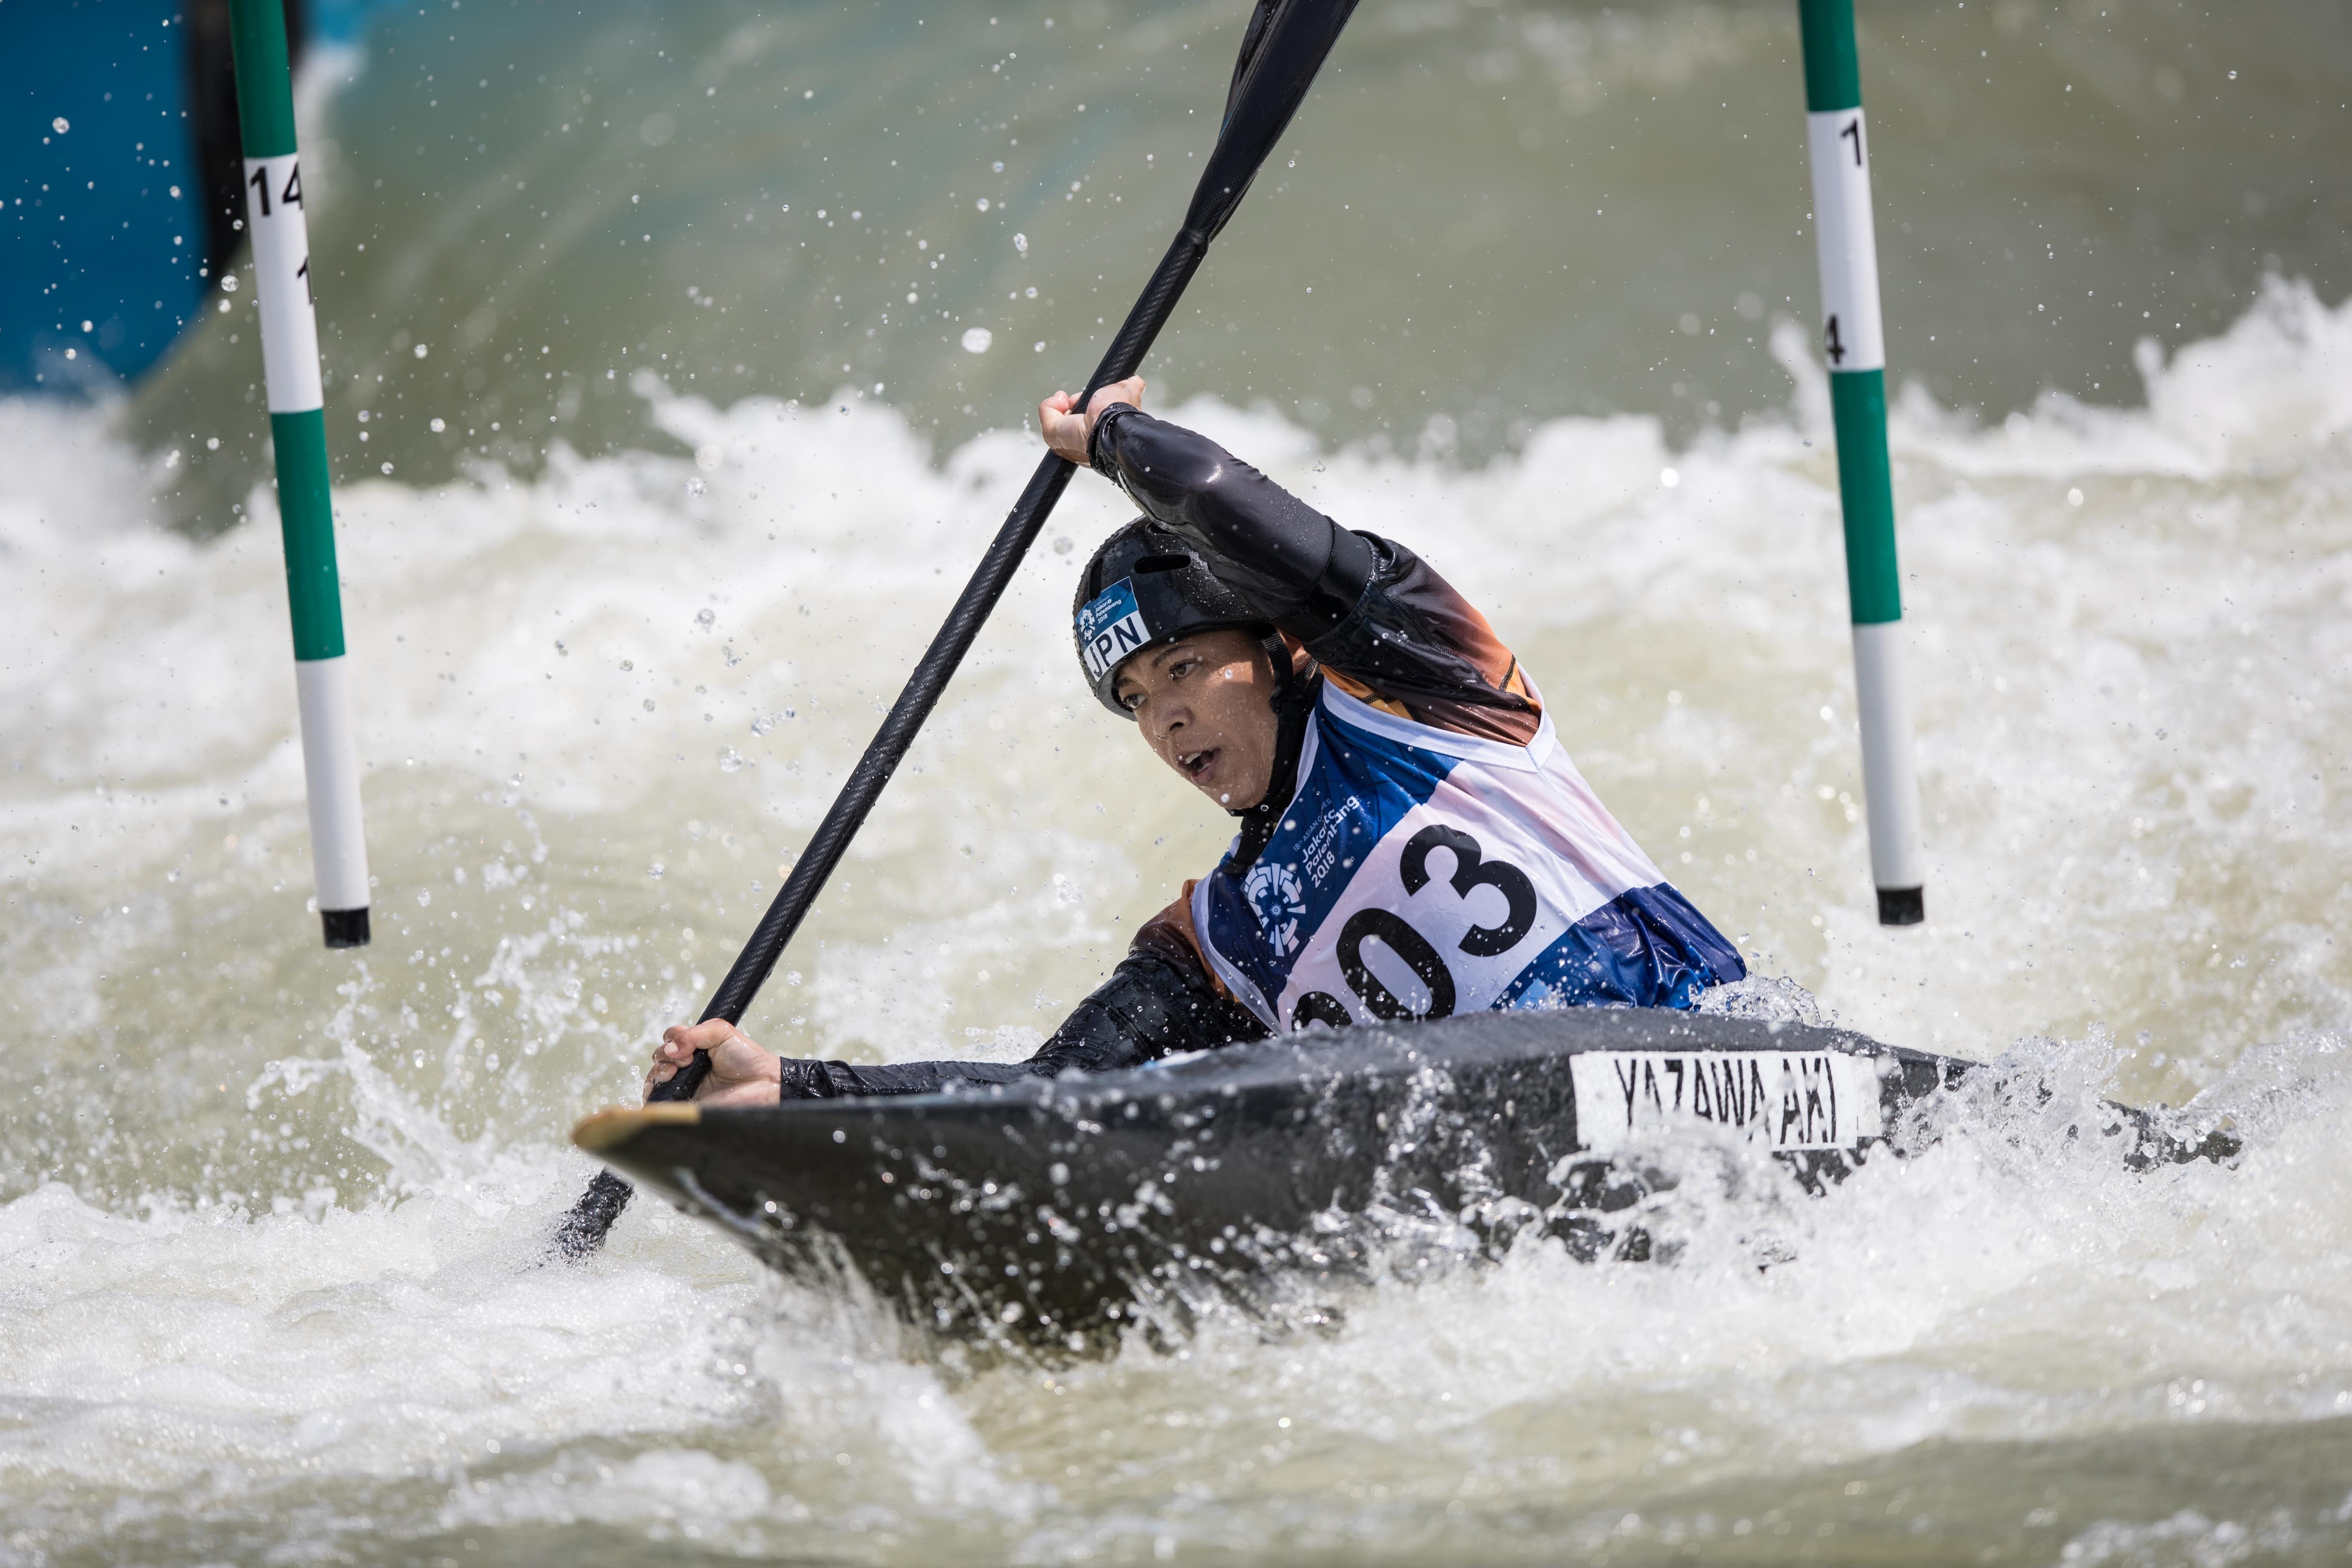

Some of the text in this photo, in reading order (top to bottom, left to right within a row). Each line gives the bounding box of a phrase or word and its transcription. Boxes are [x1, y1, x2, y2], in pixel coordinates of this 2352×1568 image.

[1840, 117, 1862, 167] 1
[250, 161, 303, 217] 14
[1096, 599, 1122, 619] Palembang
[1097, 613, 1108, 624] 2018
[1089, 616, 1142, 678] JPN
[1292, 839, 1303, 851] 18th
[1303, 820, 1319, 842] ASIAN
[1311, 850, 1335, 888] 2018
[1780, 1057, 1836, 1145] AKI
